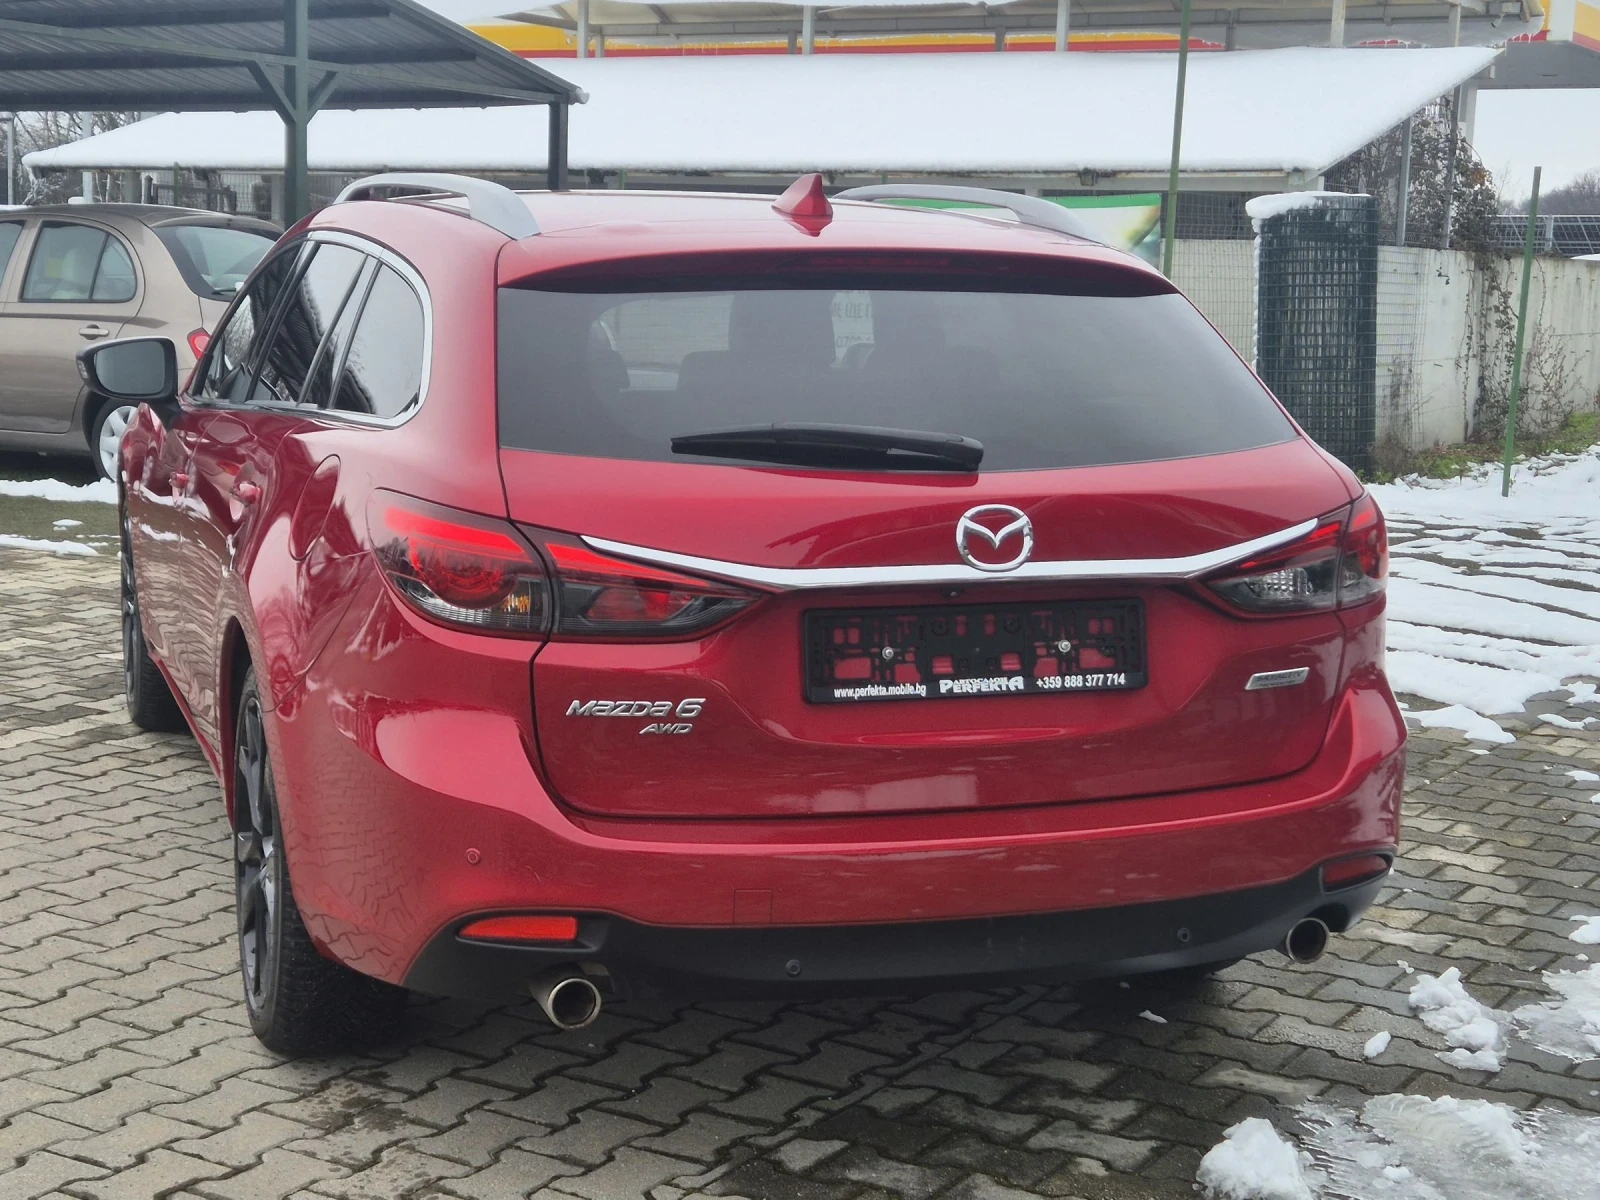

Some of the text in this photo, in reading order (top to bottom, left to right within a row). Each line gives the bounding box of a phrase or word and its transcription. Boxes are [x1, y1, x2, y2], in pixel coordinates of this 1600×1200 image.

[1036, 673, 1126, 689] +359 888 377 714
[834, 683, 927, 699] www.perfekta.mobile.bg
[675, 697, 707, 718] 6
[639, 722, 693, 735] AWD
